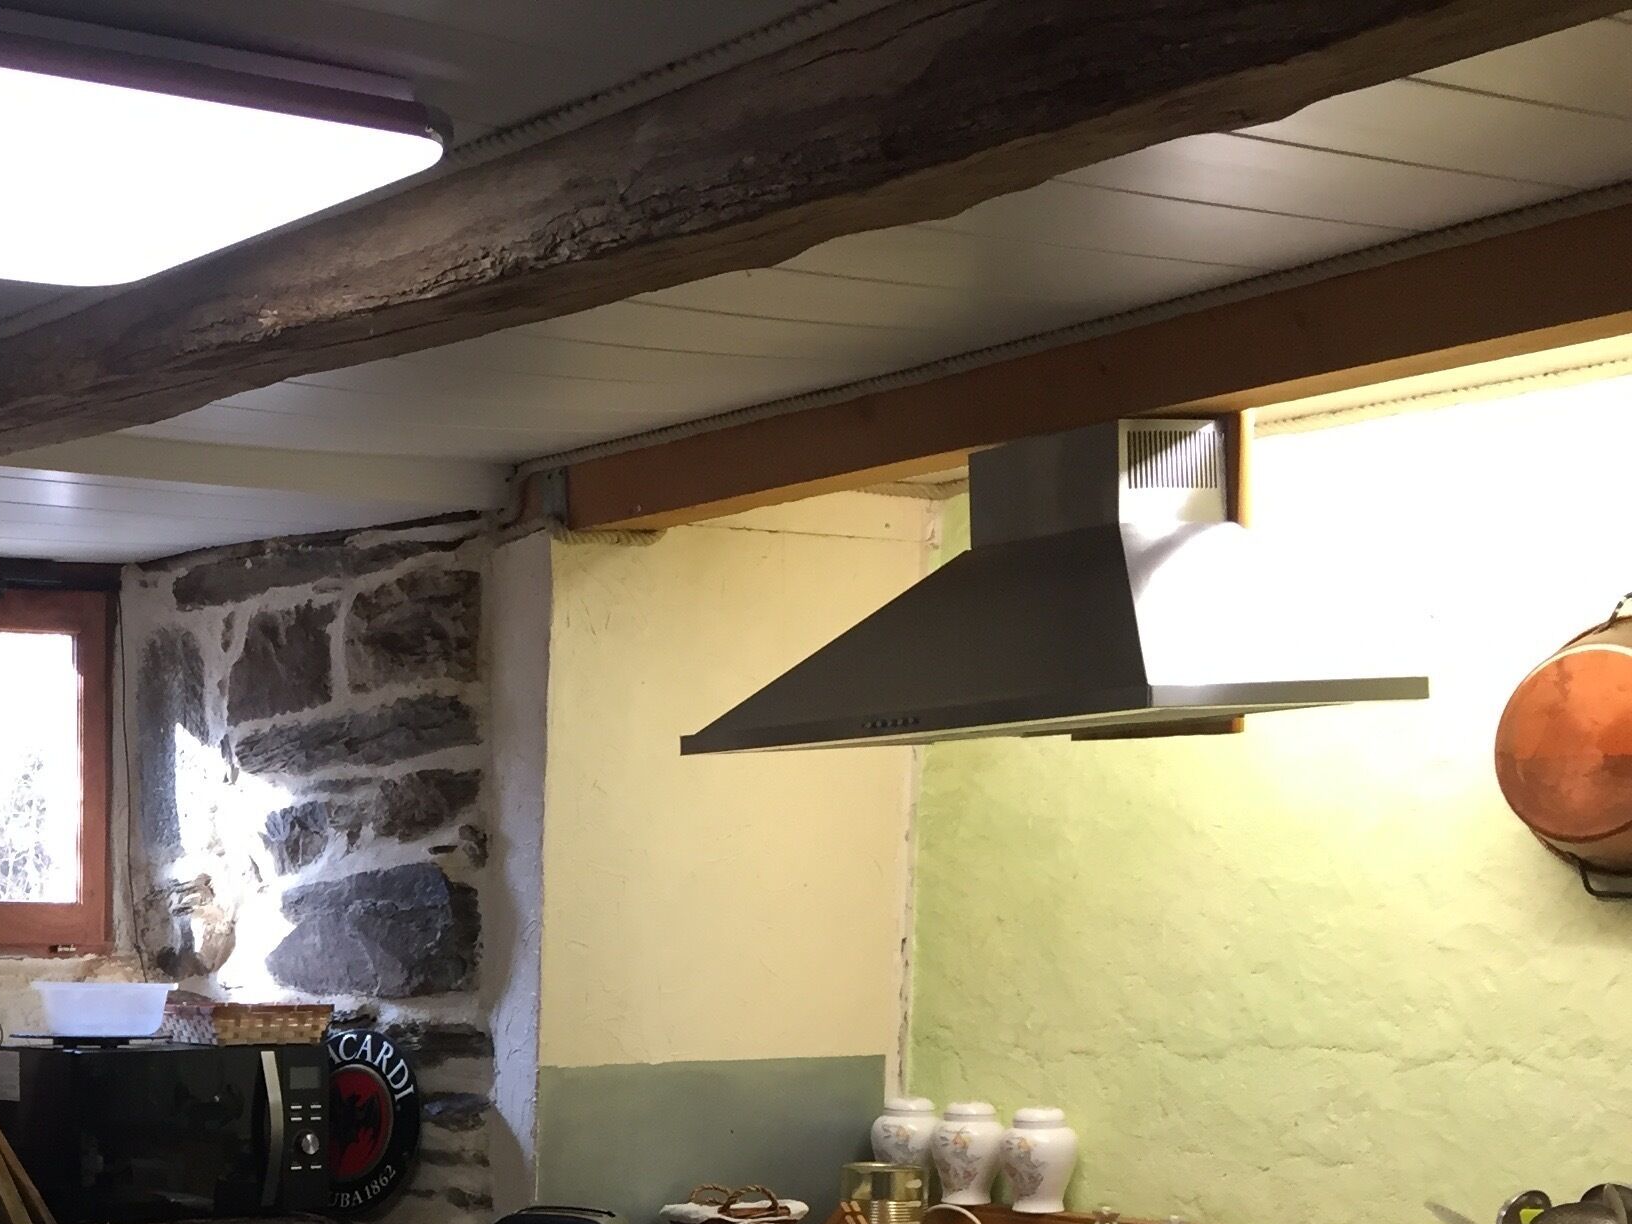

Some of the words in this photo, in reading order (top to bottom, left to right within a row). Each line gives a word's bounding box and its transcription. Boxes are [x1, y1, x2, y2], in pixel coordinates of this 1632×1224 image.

[327, 1033, 415, 1102] ACARDI
[326, 1189, 364, 1208] UBA
[364, 1164, 396, 1200] 1862
